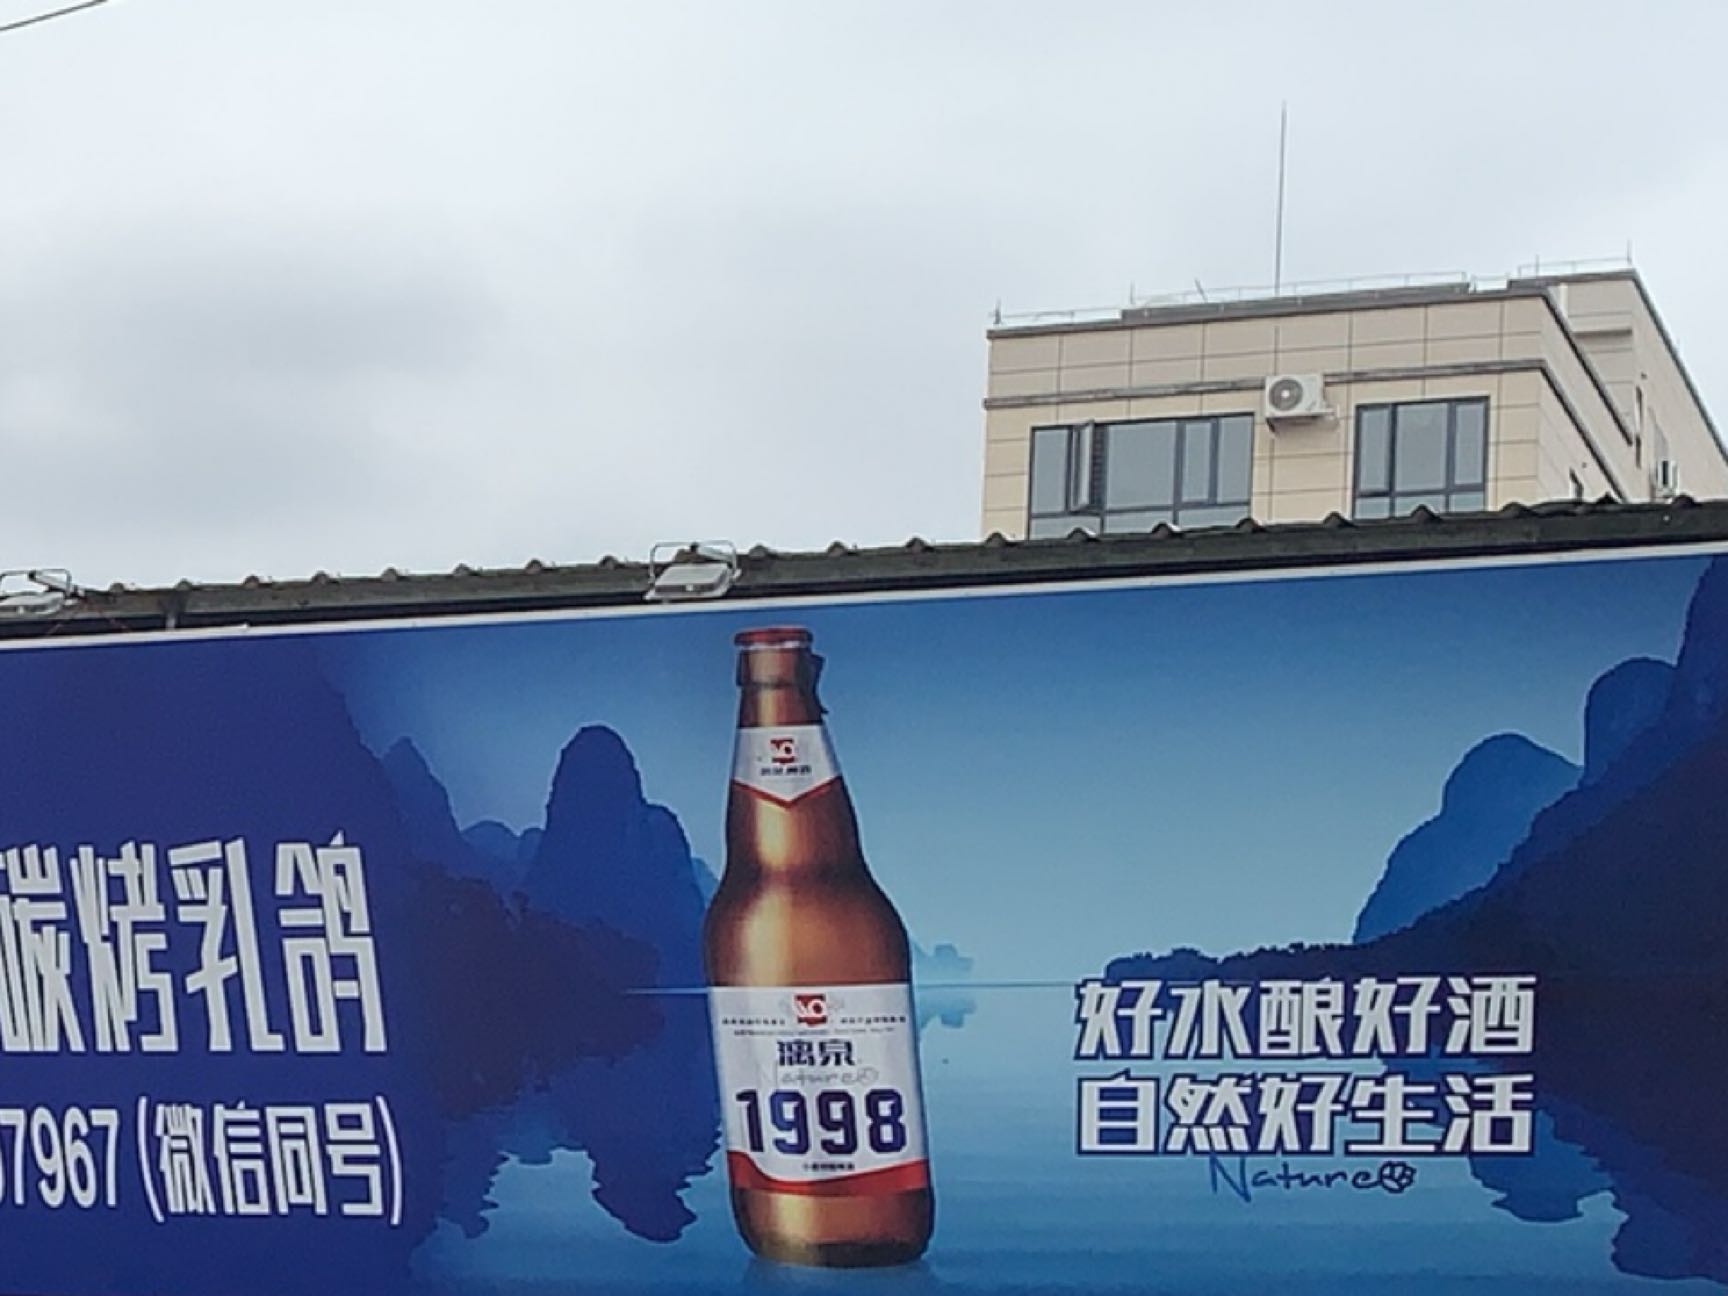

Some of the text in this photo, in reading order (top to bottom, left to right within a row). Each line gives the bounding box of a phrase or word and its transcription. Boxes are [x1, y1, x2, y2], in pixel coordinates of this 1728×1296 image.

[1076, 974, 1538, 1057] 好水酿好酒
[735, 1087, 908, 1156] 1998
[1077, 1070, 1535, 1155] 自然好生活
